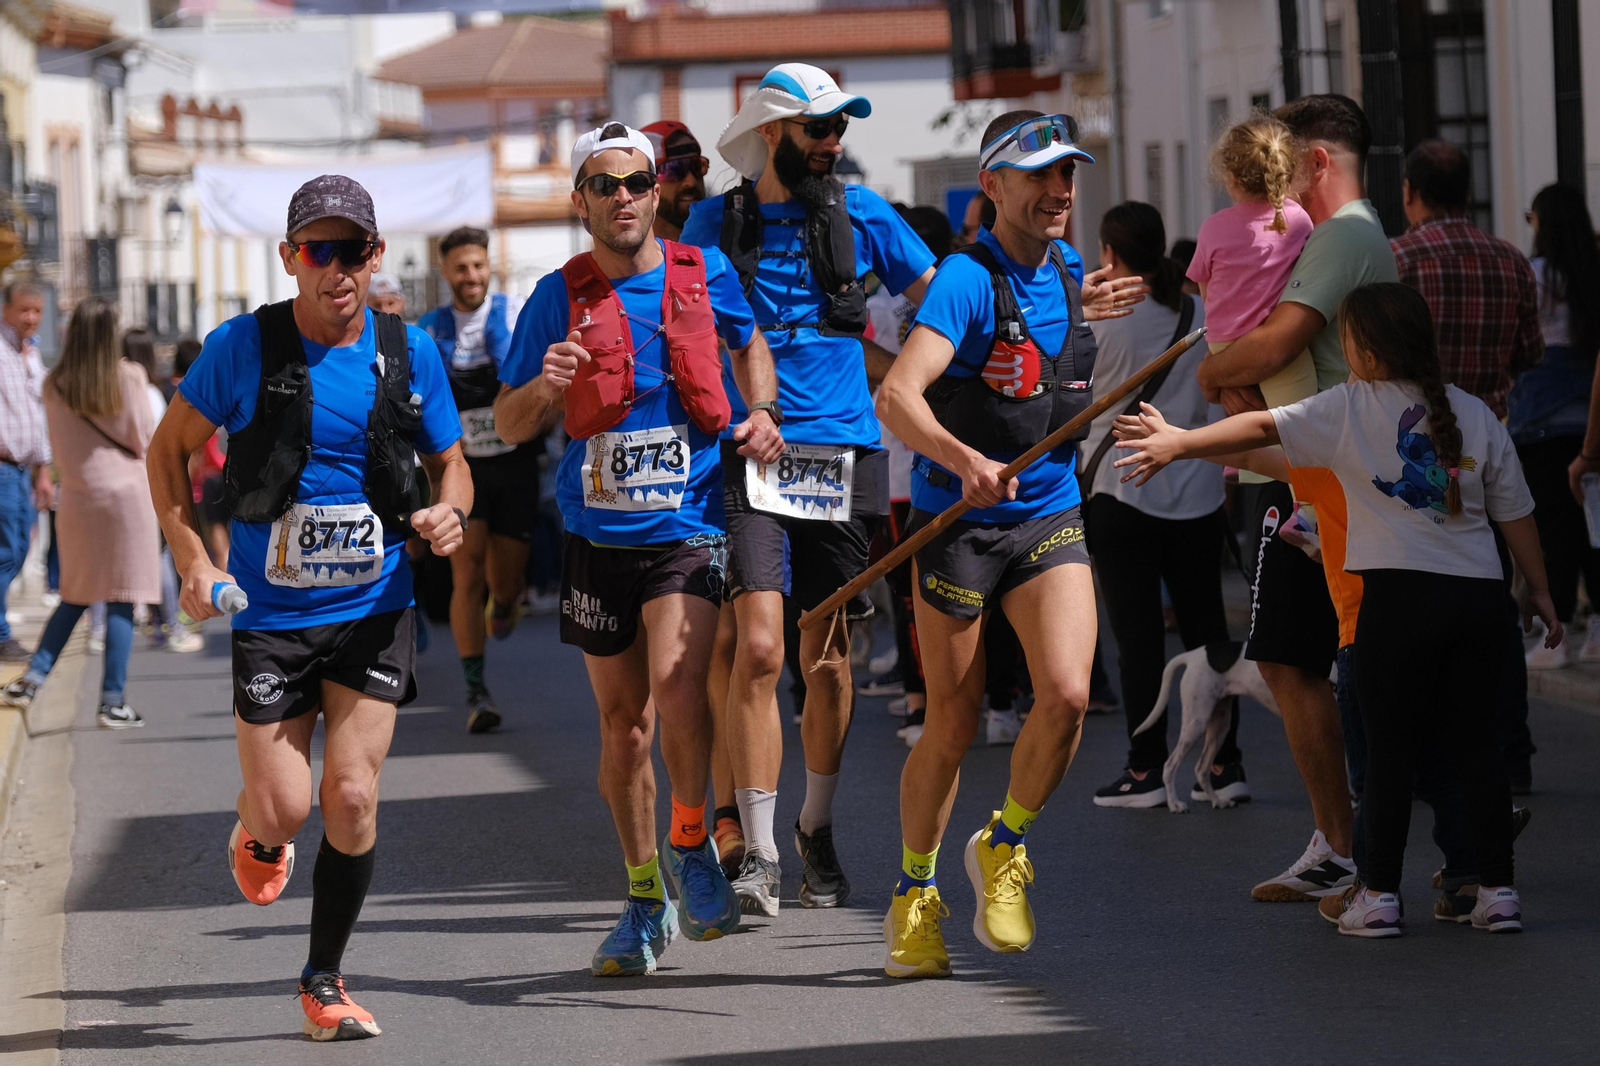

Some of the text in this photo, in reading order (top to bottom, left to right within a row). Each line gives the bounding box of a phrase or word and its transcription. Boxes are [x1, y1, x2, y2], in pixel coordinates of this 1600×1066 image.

[611, 441, 684, 475] 8773
[777, 457, 843, 485] 8771
[298, 519, 375, 549] 8772
[1249, 505, 1280, 640] Champion
[574, 607, 618, 632] SANTO
